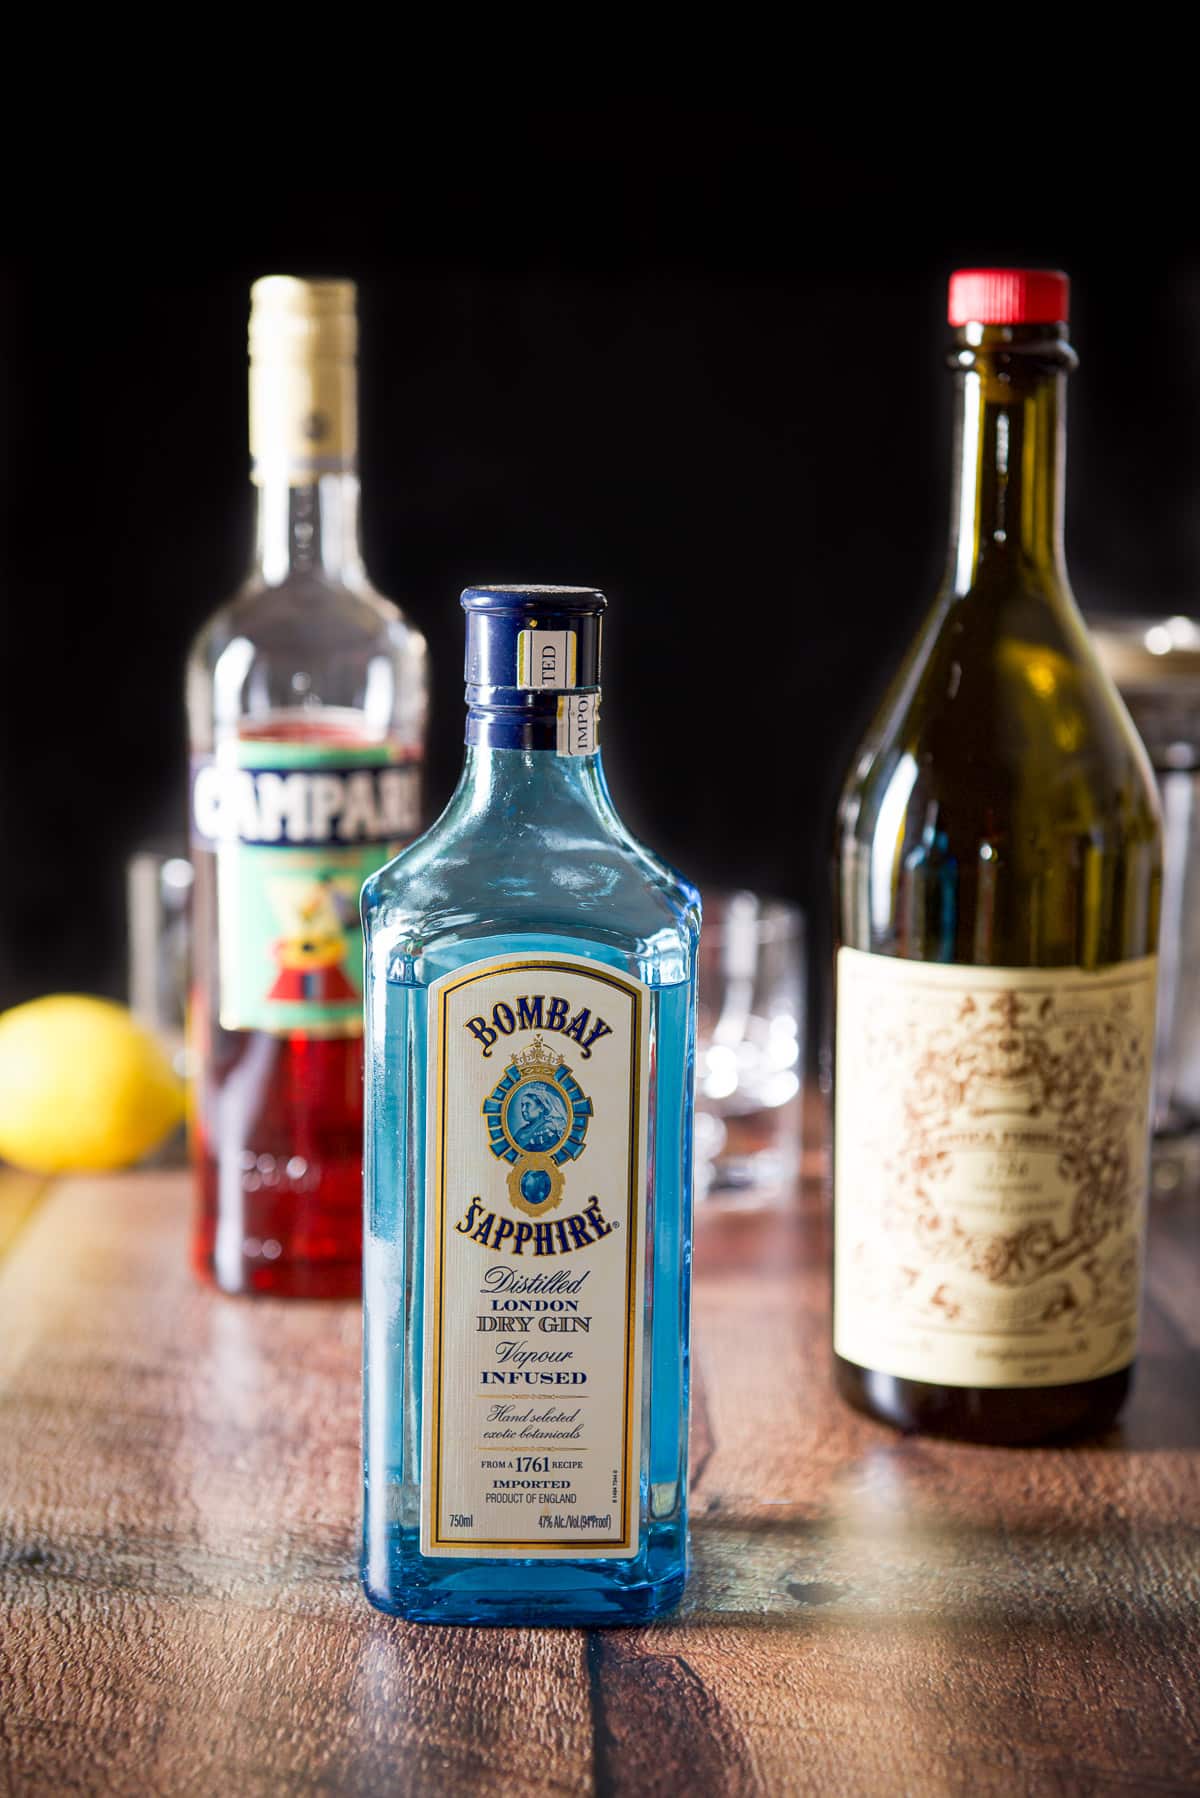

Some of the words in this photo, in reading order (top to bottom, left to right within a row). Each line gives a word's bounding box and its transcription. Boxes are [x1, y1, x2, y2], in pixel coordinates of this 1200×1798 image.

[542, 645, 556, 687] TED
[577, 695, 590, 749] IMPO
[464, 994, 614, 1060] BOMBAY
[479, 1265, 591, 1296] Distilled
[491, 1299, 579, 1312] LONDON
[475, 1316, 535, 1333] DRY
[538, 1316, 593, 1333] GIN
[495, 1340, 574, 1370] Vapour
[479, 1371, 588, 1385] INFUSED
[486, 1404, 530, 1423] Hand
[529, 1408, 582, 1423] selected
[483, 1429, 517, 1440] exotic
[519, 1424, 585, 1440] botanicals
[480, 1460, 506, 1469] FROM
[507, 1460, 514, 1469] A
[515, 1456, 551, 1473] 1761
[552, 1461, 584, 1469] RECIPE
[492, 1480, 571, 1489] IMPORTED
[485, 1493, 524, 1504] PRODUCT
[525, 1493, 537, 1504] OF
[538, 1493, 577, 1505] ENGLAND
[449, 1514, 473, 1528] 750ml
[538, 1515, 553, 1529] 47%
